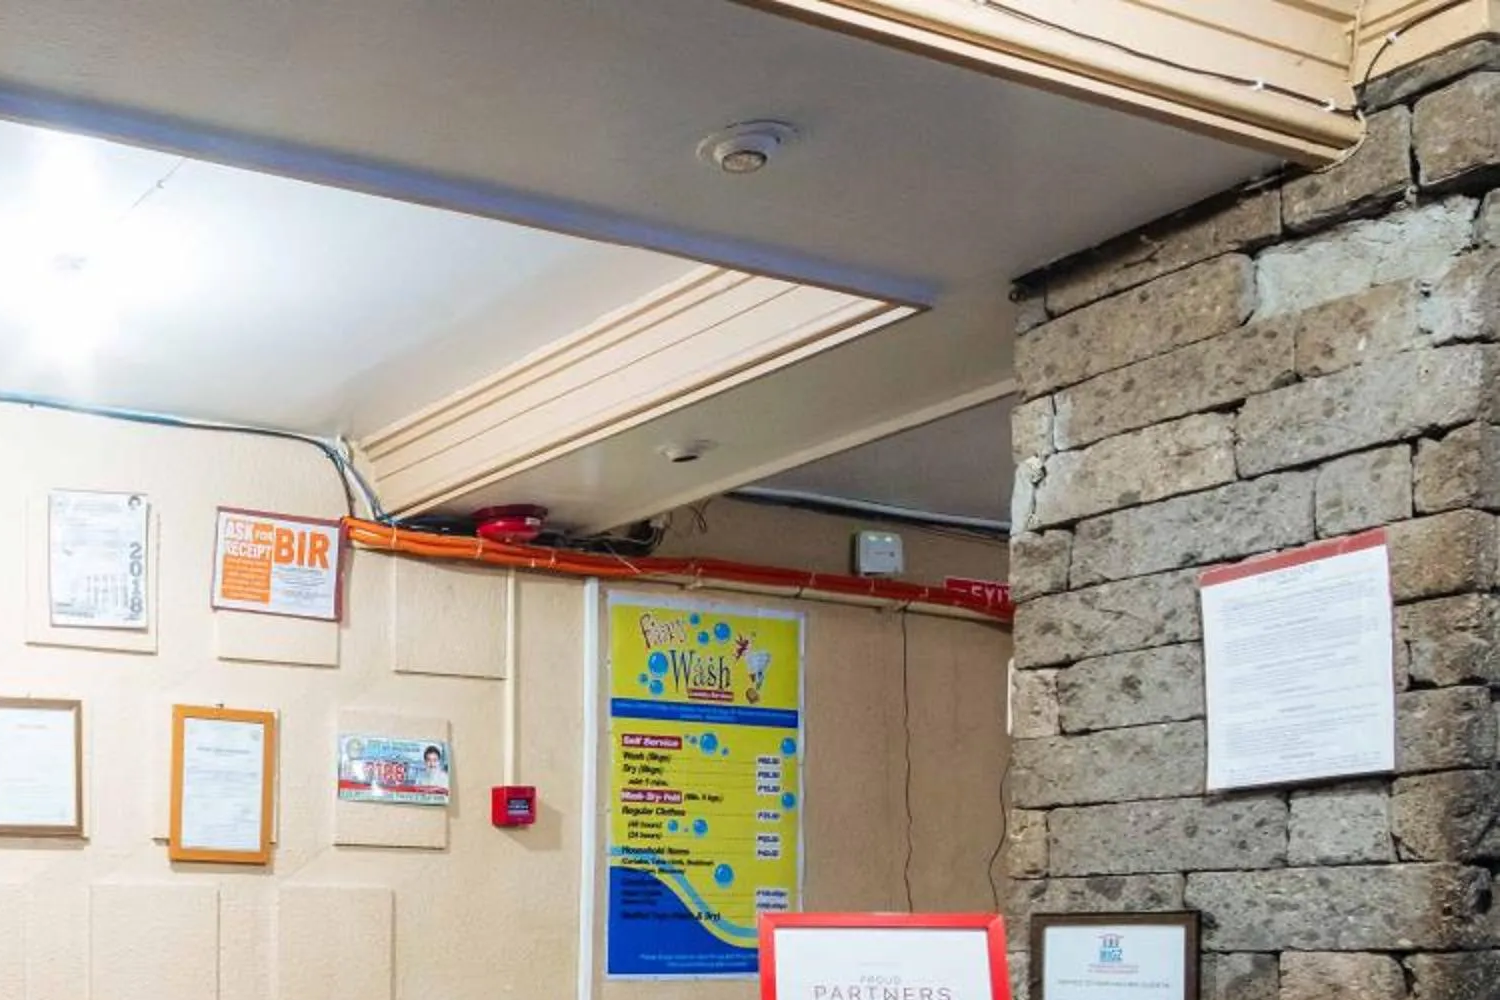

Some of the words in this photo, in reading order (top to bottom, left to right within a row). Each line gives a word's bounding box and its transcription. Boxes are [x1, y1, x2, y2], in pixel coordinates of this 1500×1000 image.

[225, 520, 252, 541] ASK
[225, 541, 272, 559] RECEIPT
[275, 527, 330, 569] BIR
[668, 649, 732, 694] Wash
[621, 805, 654, 817] Regular
[655, 806, 687, 817] Clothes
